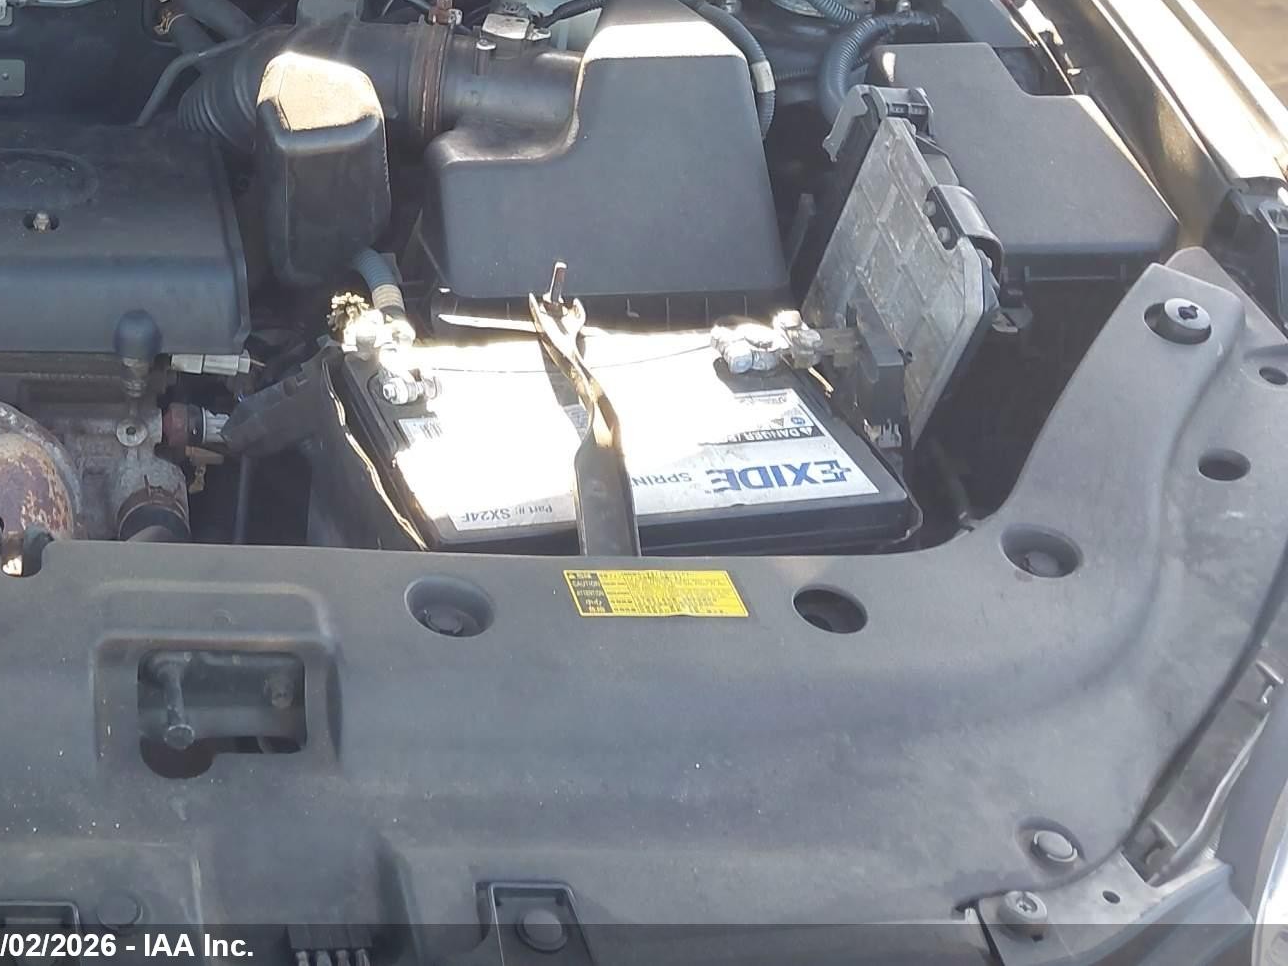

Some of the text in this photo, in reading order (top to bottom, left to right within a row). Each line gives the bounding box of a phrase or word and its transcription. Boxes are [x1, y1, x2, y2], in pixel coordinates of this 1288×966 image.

[744, 427, 801, 442] DANGER
[705, 459, 851, 493] EXIDE
[528, 504, 553, 514] Part
